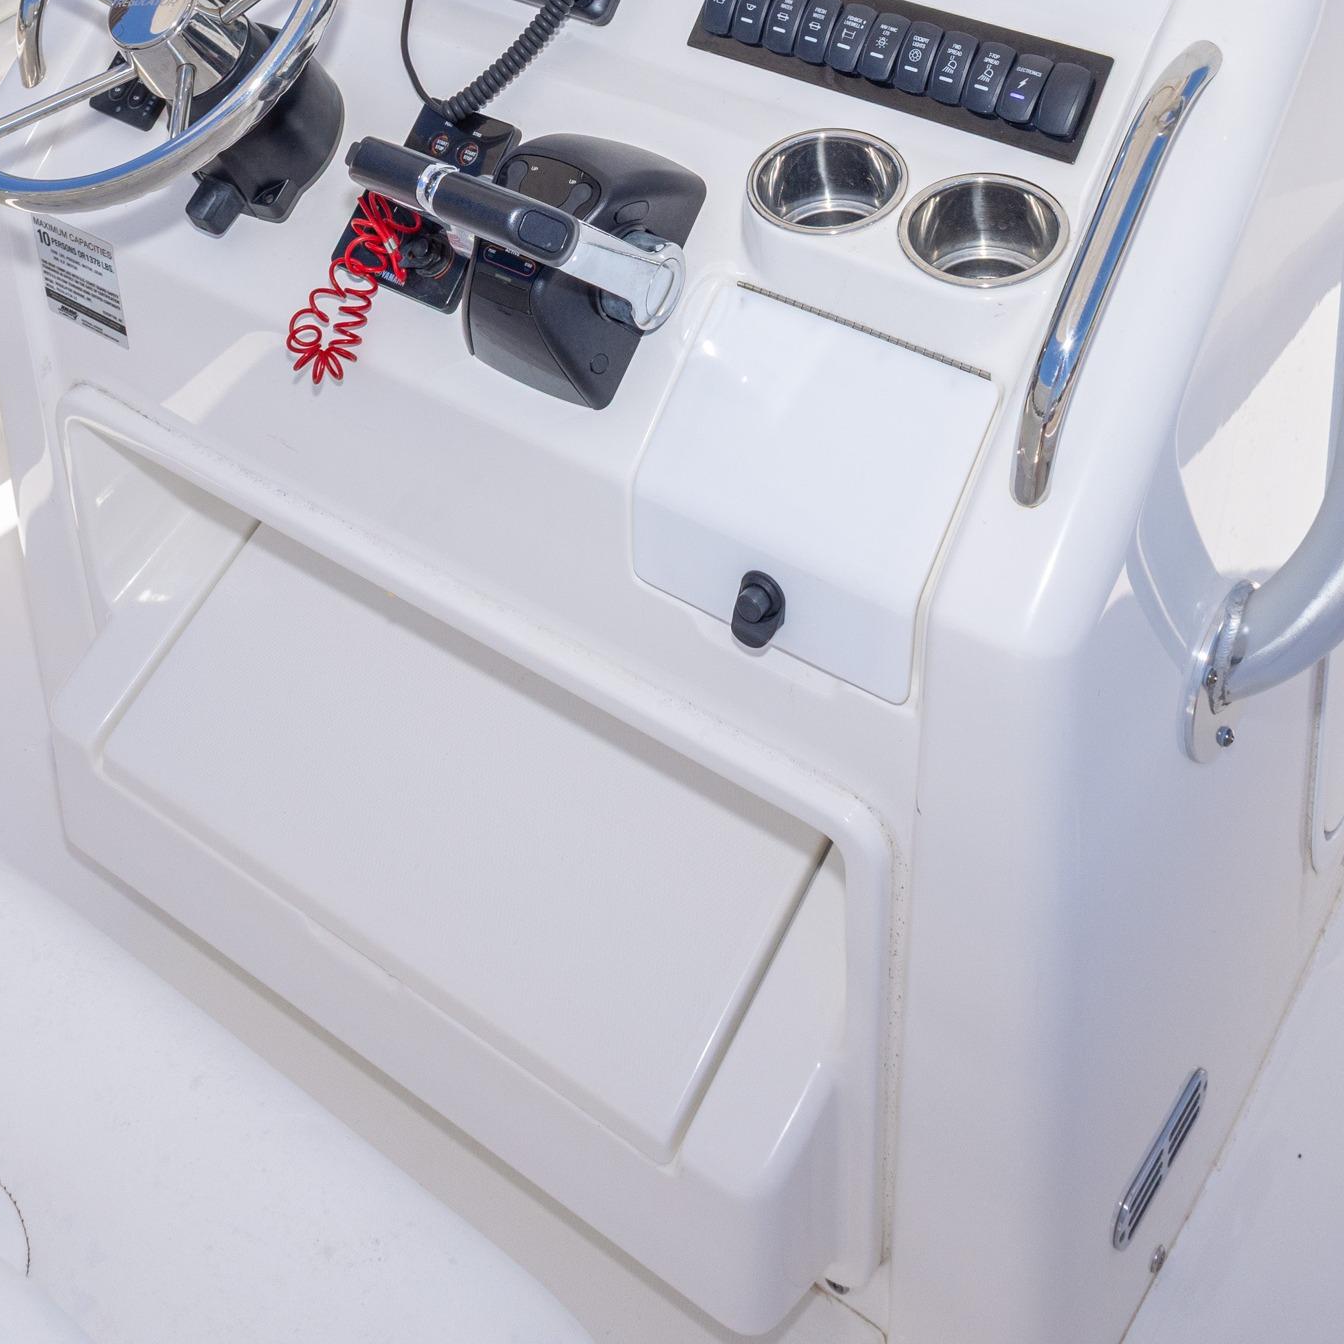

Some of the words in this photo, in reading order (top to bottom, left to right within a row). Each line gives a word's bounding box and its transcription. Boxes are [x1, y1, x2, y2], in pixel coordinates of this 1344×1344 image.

[913, 35, 930, 44] COCKPIT
[912, 41, 927, 49] LIGHTS
[947, 48, 963, 57] SPREAD
[984, 57, 1000, 66] SPREAD
[1016, 66, 1043, 78] ELECTRONICS
[464, 149, 477, 157] START
[33, 216, 68, 239] MAXIMUM
[69, 233, 113, 260] CAPACITIES
[37, 229, 50, 246] 10
[50, 237, 77, 256] PERSONS
[77, 250, 86, 260] OR
